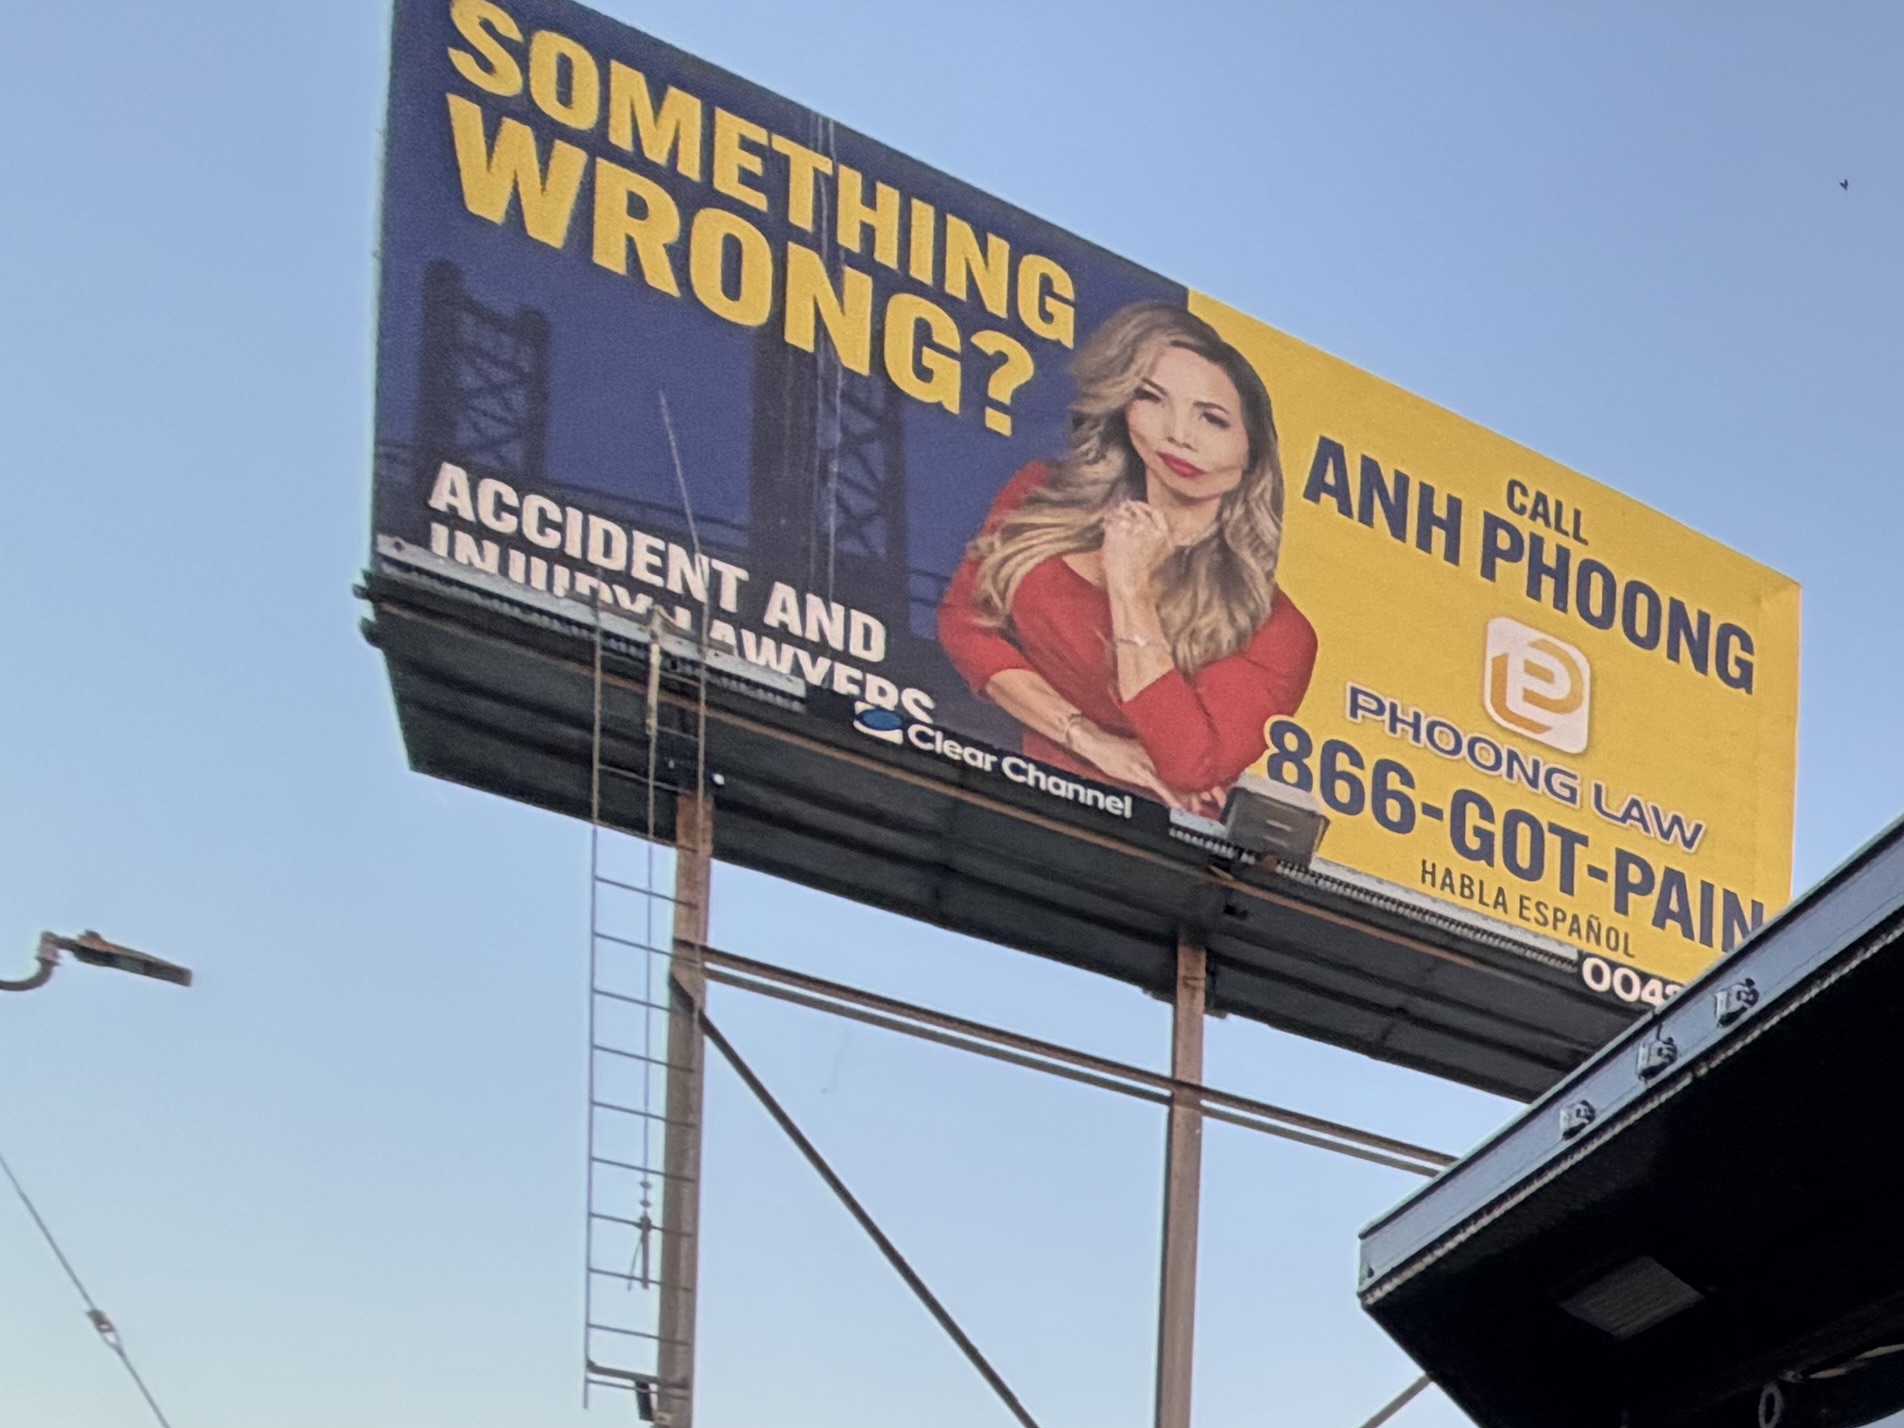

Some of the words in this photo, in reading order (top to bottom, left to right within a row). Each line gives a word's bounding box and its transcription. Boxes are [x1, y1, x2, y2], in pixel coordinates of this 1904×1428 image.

[446, 93, 1035, 437] WRONG?
[447, 0, 1076, 349] SOMETHING
[428, 461, 750, 613] ACCIDENT
[764, 581, 886, 663] AND
[1302, 434, 1463, 567] ANH
[1480, 510, 1755, 695] PHOONG
[1506, 478, 1589, 546] CALL
[907, 723, 998, 772] Clear
[1001, 755, 1133, 819] Channel
[1266, 718, 1764, 953] 866-GOT-PAIN
[1348, 683, 1580, 806] PHOONG
[1593, 781, 1704, 852] LAW
[1421, 858, 1509, 915] HABLA
[1518, 893, 1636, 958] ESPAÑOL
